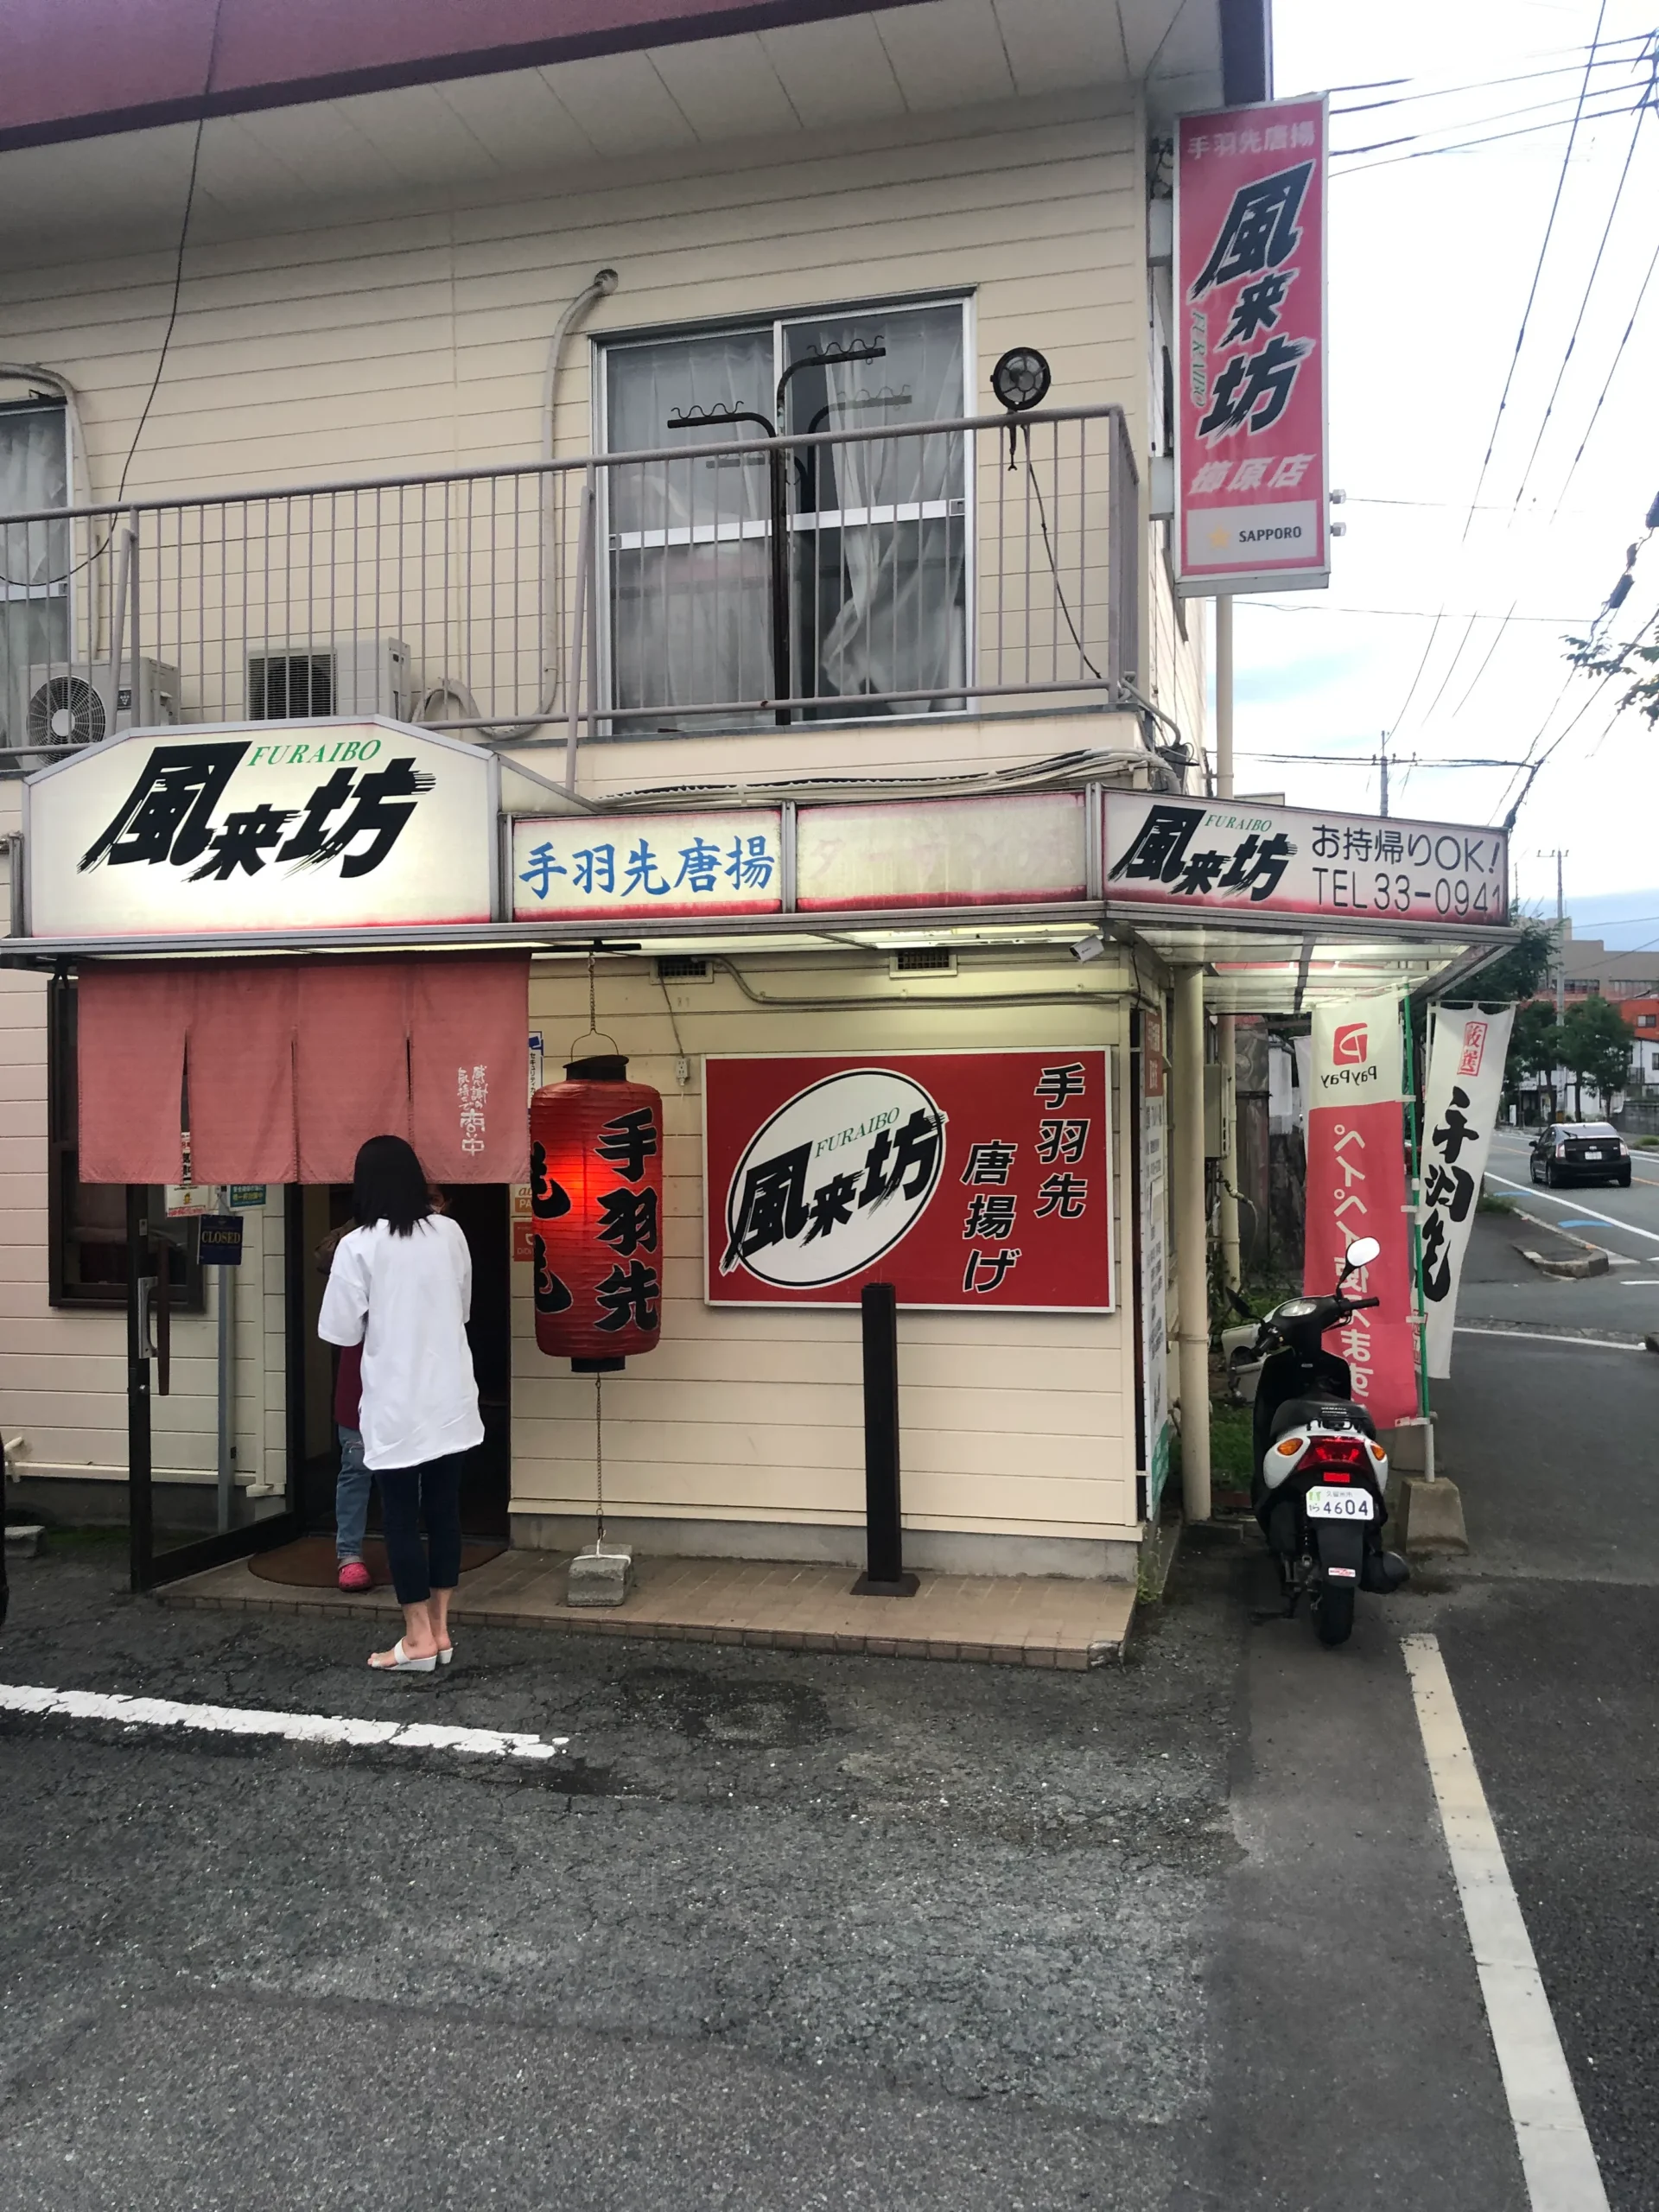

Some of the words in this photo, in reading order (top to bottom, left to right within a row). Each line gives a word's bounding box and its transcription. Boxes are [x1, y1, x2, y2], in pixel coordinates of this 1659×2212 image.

[1239, 525, 1302, 543] SAPPORO
[247, 739, 382, 767] FURAIBO
[76, 741, 437, 882] 風来坊
[1204, 814, 1273, 833] FURAIBO
[518, 835, 776, 899] 手羽先唐揚
[1108, 804, 1299, 901] 風来坊
[815, 1107, 900, 1160] FURAIBO
[1033, 1062, 1090, 1219] 手羽先
[519, 1198, 533, 1209] PA
[594, 1107, 659, 1332] 手羽先
[719, 1109, 950, 1276] 風来坊
[960, 1140, 1022, 1294] 唐揚げ
[201, 1230, 241, 1244] CLOSED
[1323, 1499, 1369, 1516] 4604
